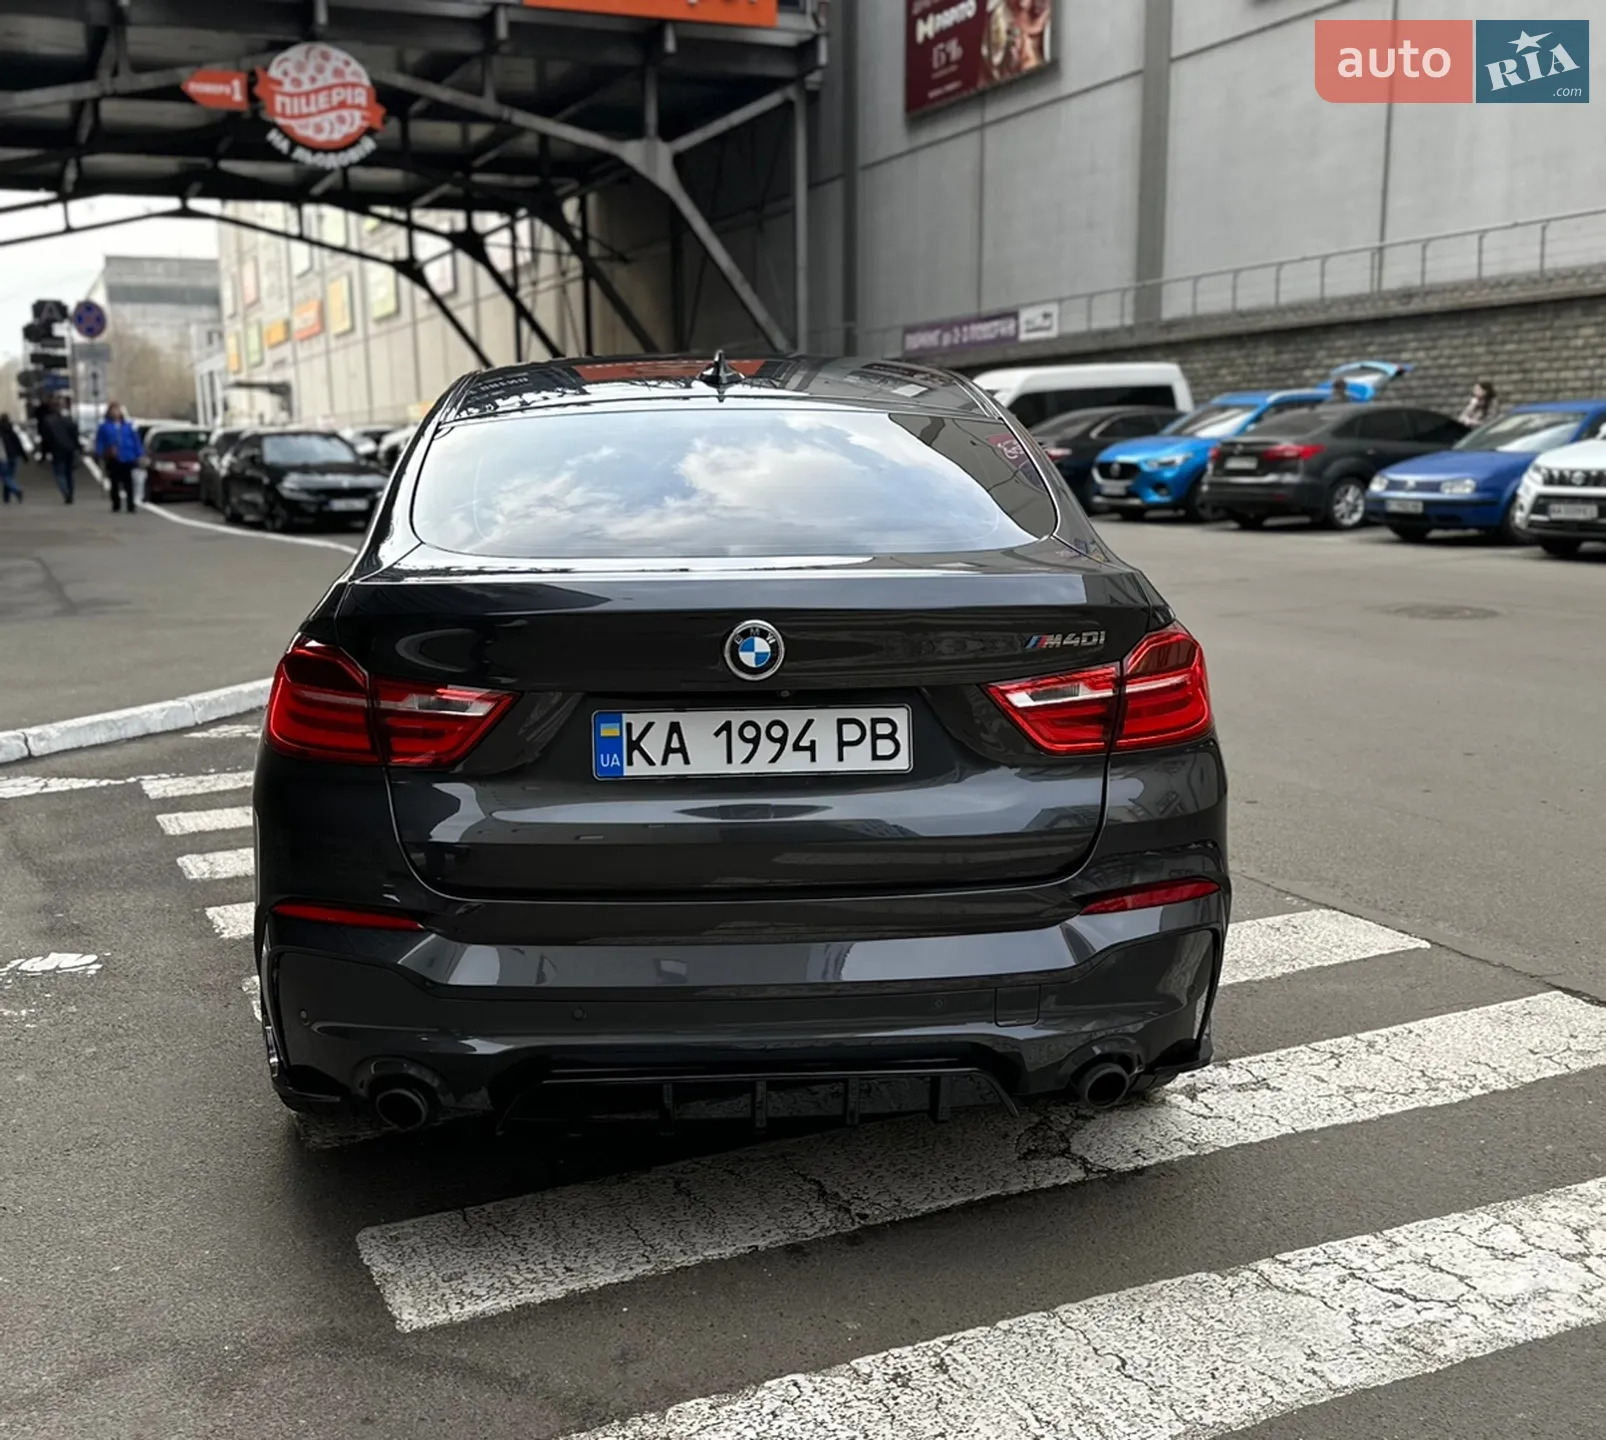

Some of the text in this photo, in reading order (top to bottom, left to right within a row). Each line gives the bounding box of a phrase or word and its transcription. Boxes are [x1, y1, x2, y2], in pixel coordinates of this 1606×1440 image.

[274, 85, 368, 117] ПІЦЕРІЯ
[733, 627, 777, 645] BMW
[625, 717, 901, 767] KA 1994 PB
[600, 753, 621, 768] UA
